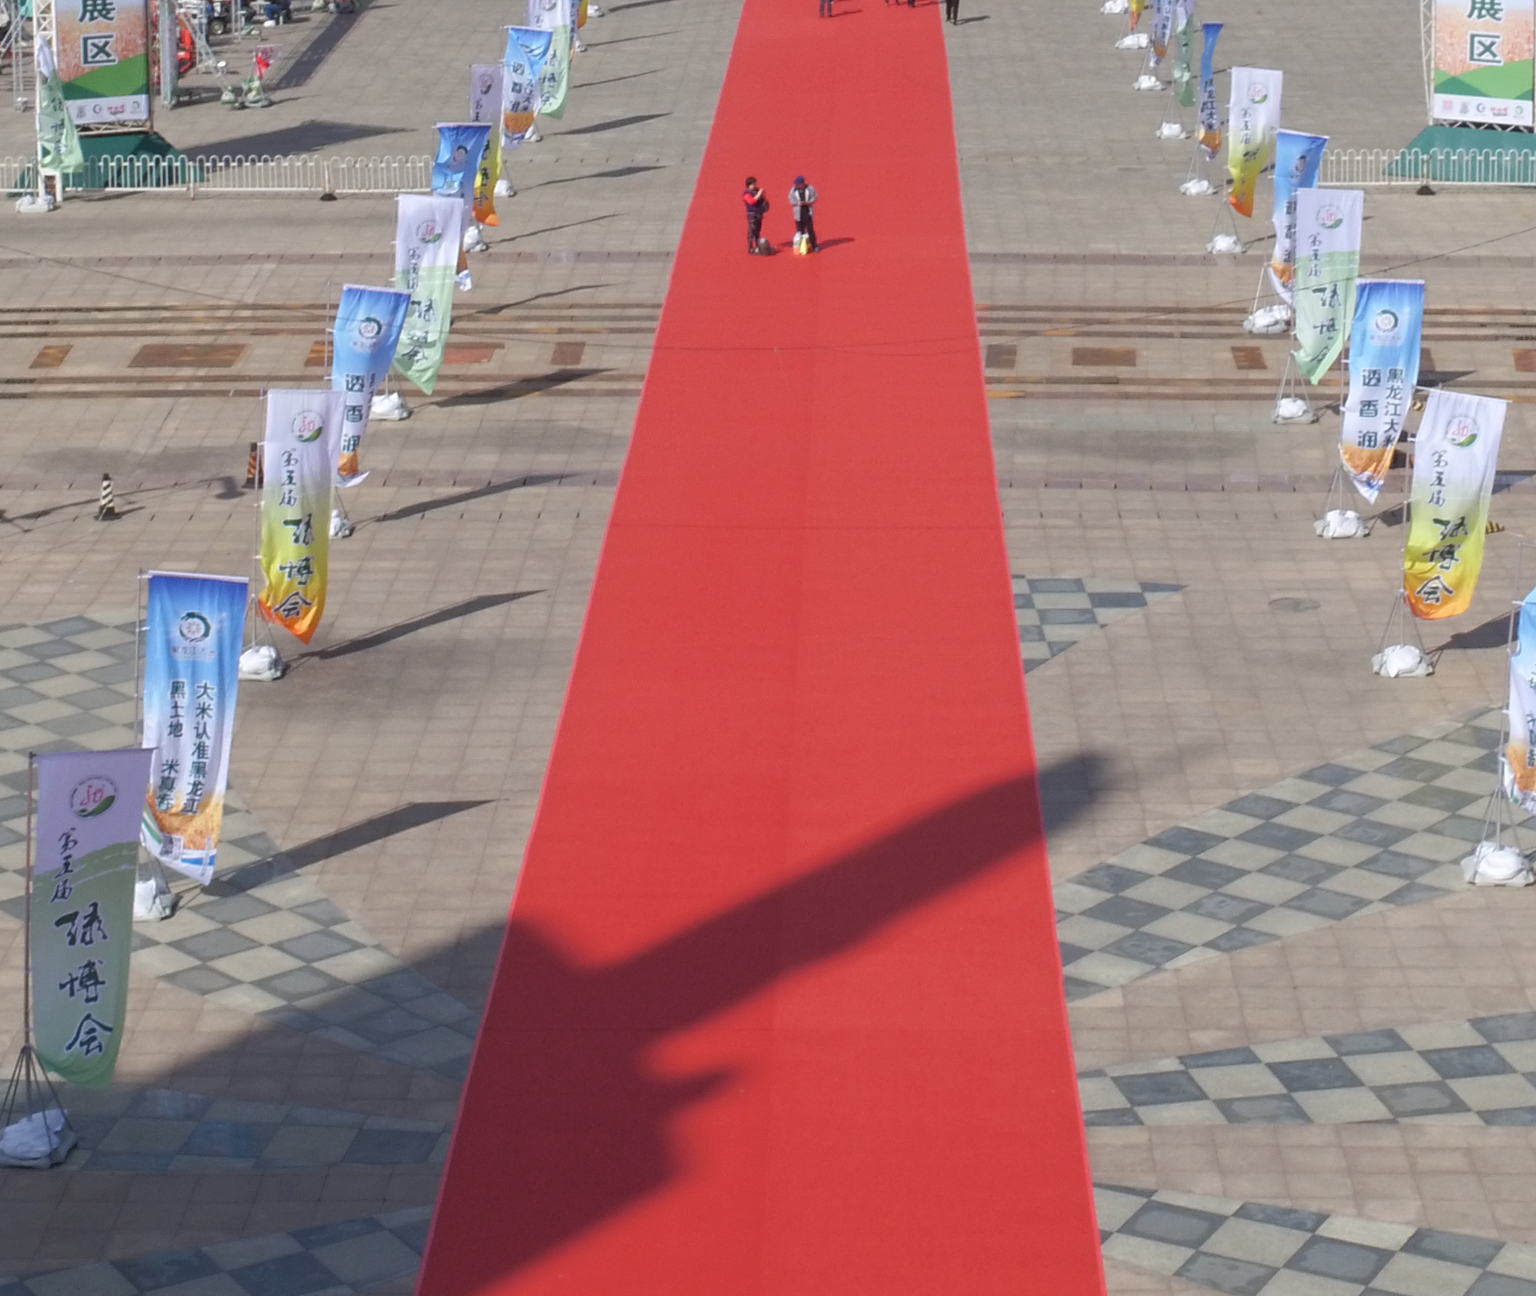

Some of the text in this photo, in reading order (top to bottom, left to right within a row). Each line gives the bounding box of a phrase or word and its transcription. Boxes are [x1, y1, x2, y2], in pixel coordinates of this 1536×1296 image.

[1428, 450, 1449, 508] 第五届
[167, 679, 188, 738] 黑土地
[181, 681, 216, 815] 大米认准黑龙江
[50, 829, 78, 904] 第五届
[54, 901, 113, 1057] 绿博会
